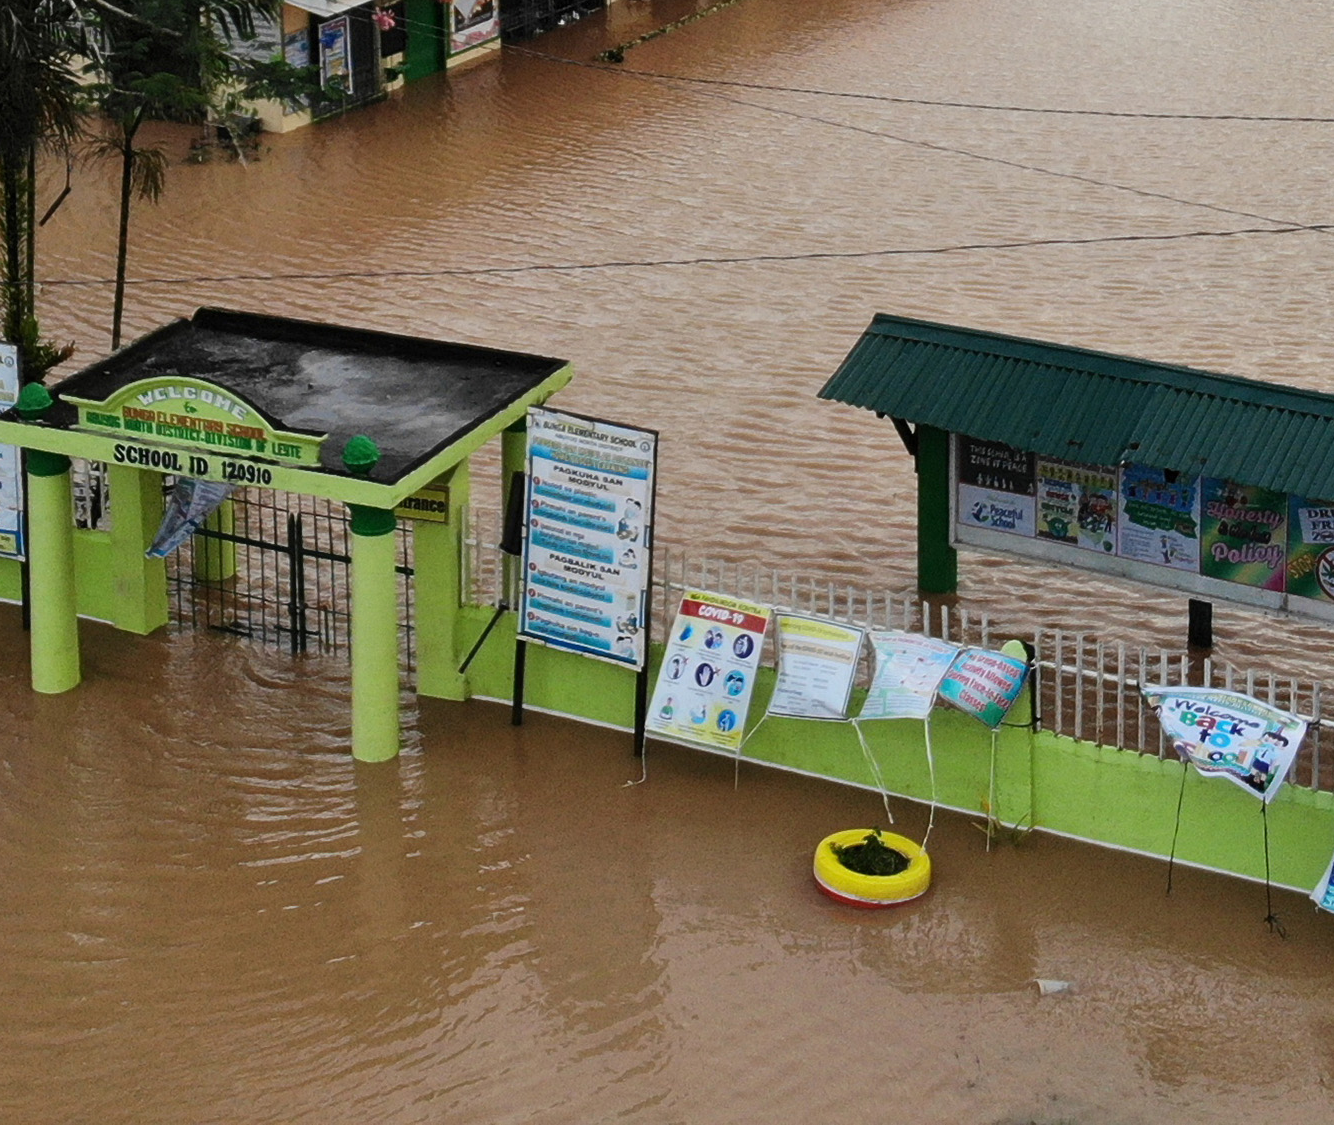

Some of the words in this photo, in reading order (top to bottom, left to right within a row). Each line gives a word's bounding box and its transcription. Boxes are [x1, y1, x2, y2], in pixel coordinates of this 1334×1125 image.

[136, 386, 249, 421] WELCOME
[156, 410, 224, 433] ELEMENTARY
[226, 422, 266, 440] SCHOOL
[272, 441, 302, 459] LEYTE
[113, 443, 183, 472] SCHOOL
[188, 455, 209, 476] ID
[221, 461, 272, 485] 120910
[568, 476, 610, 491] MODYUL
[400, 496, 445, 513] trance
[990, 504, 1023, 520] Peaceful
[1207, 501, 1284, 530] Honesty
[991, 515, 1016, 529] School
[549, 553, 596, 571] PAGBALIK
[599, 566, 620, 576] SAN
[1211, 542, 1284, 569] Policy
[563, 565, 605, 580] MODYUL
[698, 604, 744, 625] COVID-19
[1174, 699, 1260, 729] Welcome
